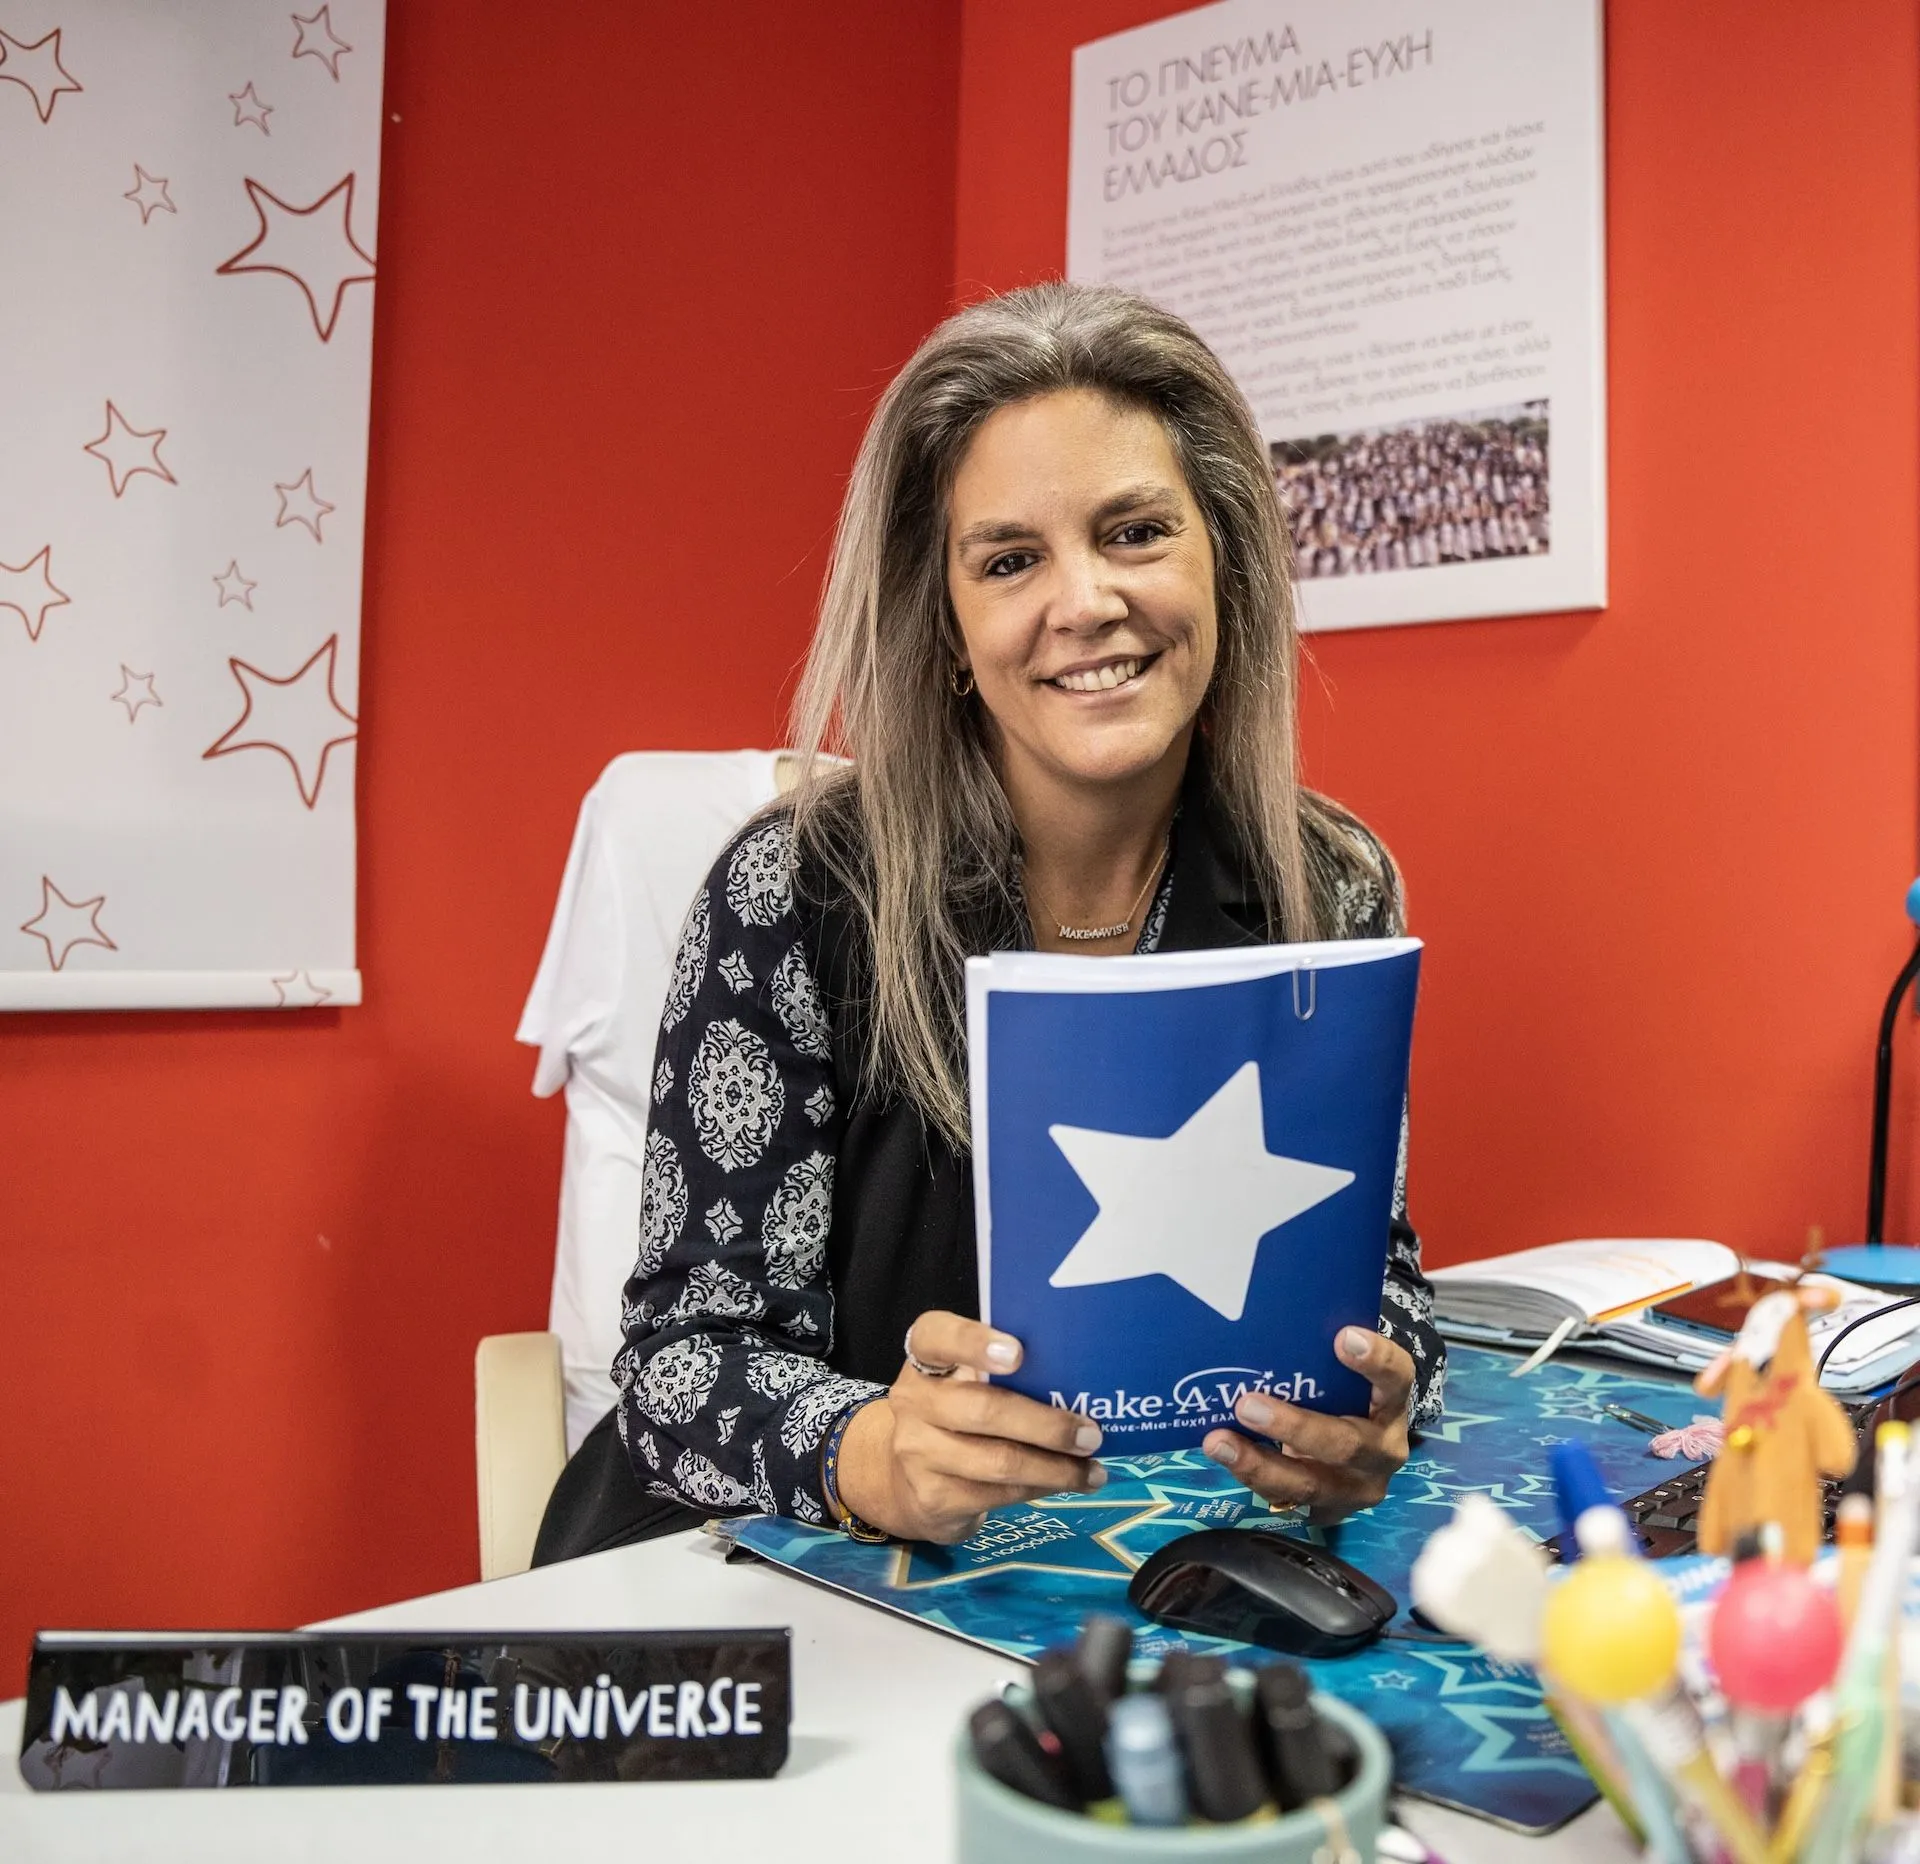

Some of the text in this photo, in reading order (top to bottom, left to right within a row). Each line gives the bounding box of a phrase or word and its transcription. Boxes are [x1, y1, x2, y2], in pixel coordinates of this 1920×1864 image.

[1105, 23, 1302, 113] ΤΟ ΠΝΕΥΜΑ
[1106, 27, 1434, 157] ΤΟΥ ΚΑΝΕ-ΜΙΑ-ΕΥΧΗ
[1103, 129, 1249, 203] ΕΛΛΑΔΟΣ
[53, 1686, 308, 1742] MANAGER
[329, 1688, 392, 1741] OF
[409, 1684, 497, 1740] THE
